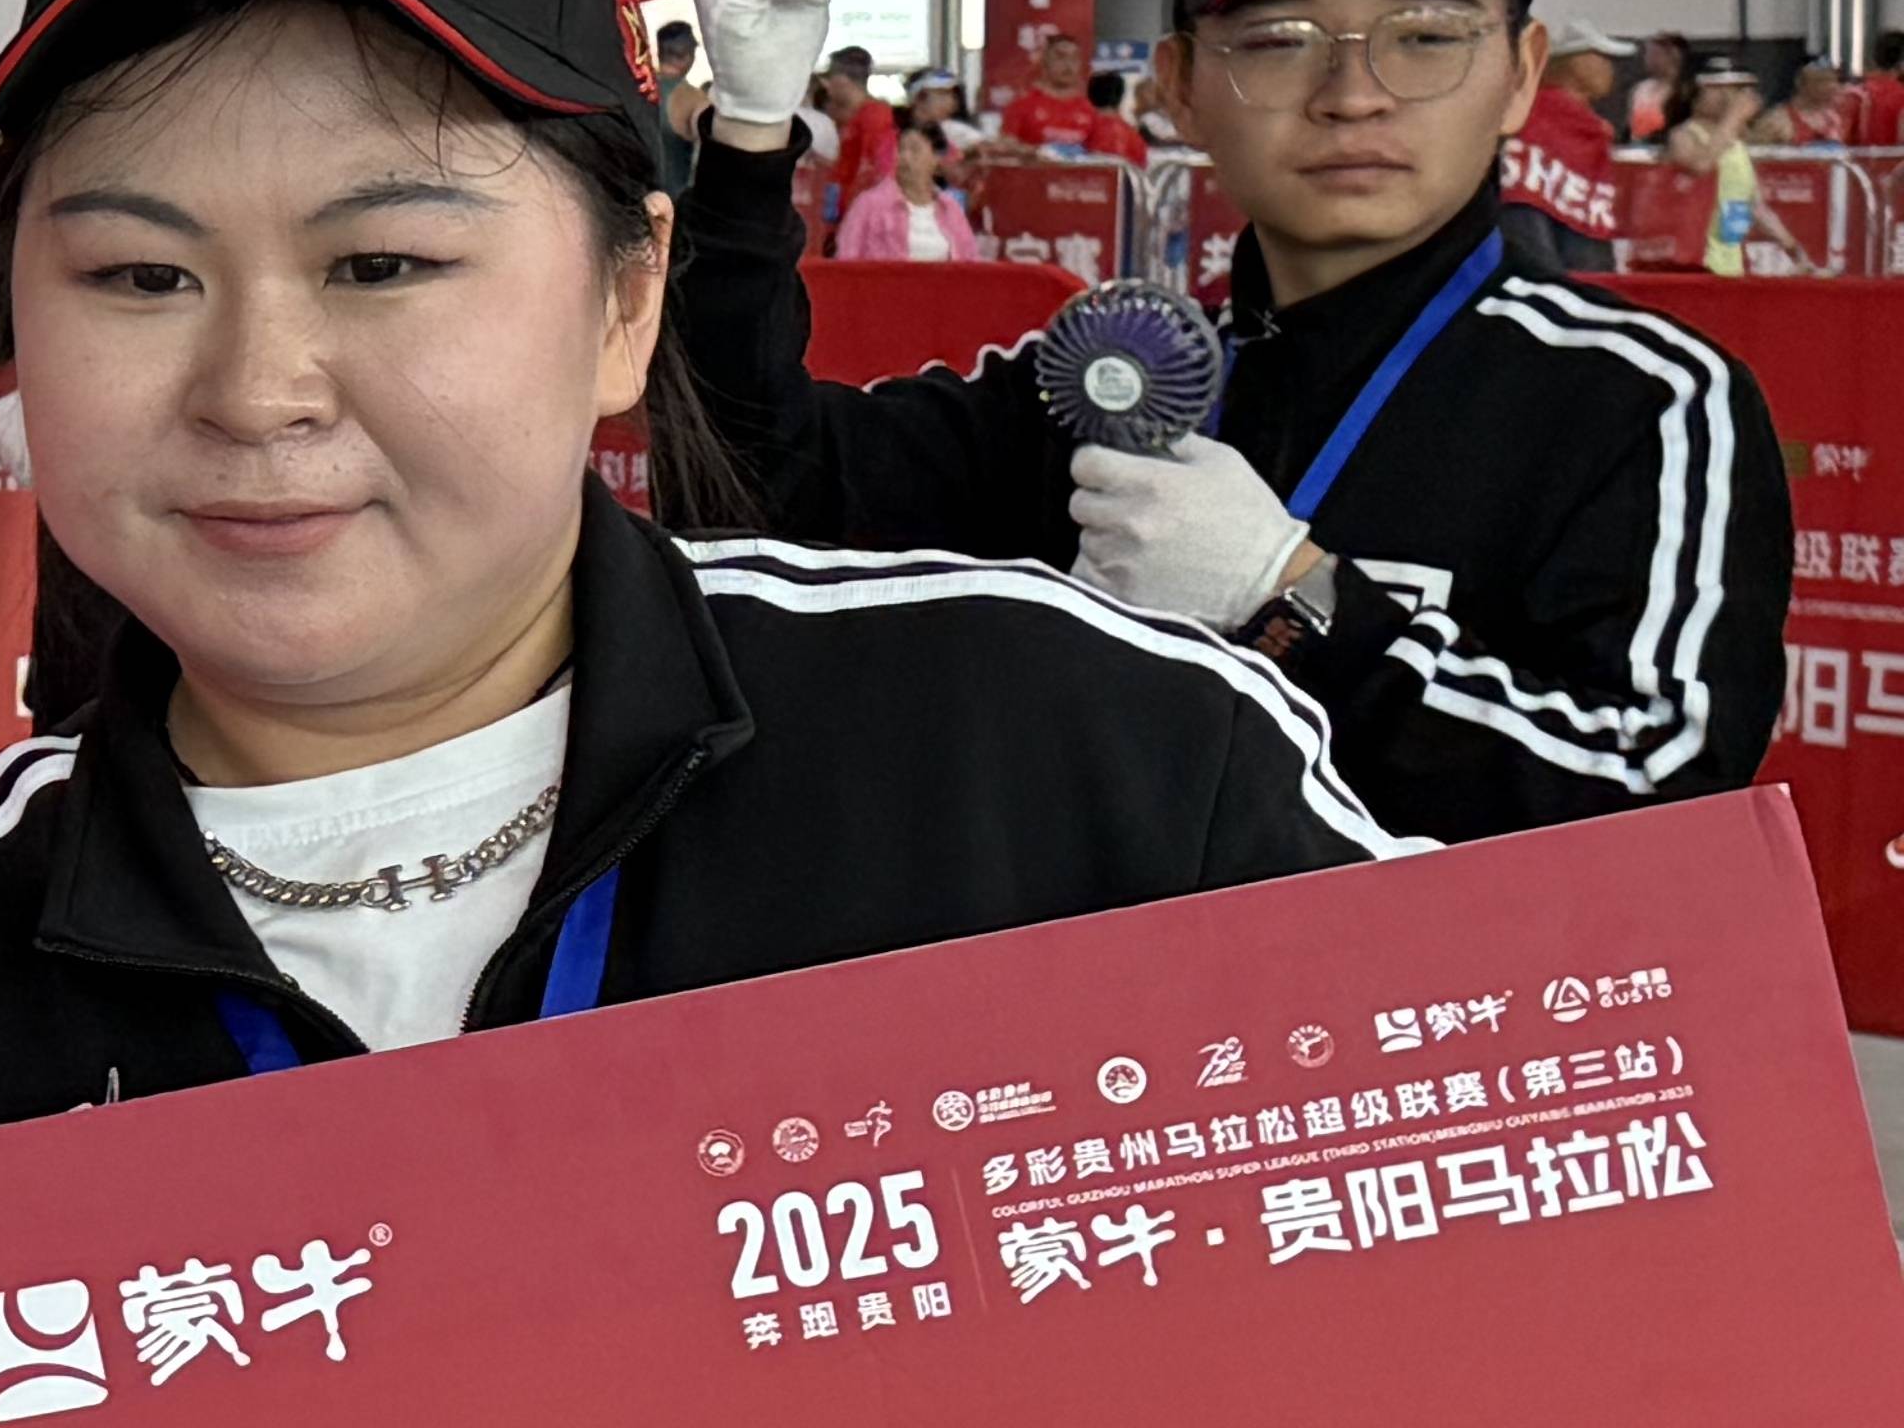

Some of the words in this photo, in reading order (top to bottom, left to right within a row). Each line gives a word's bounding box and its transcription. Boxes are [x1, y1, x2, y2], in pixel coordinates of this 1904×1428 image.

[717, 1170, 939, 1300] 2025
[118, 1238, 373, 1386] 蒙牛
[742, 1281, 952, 1350] 奔跑贵阳
